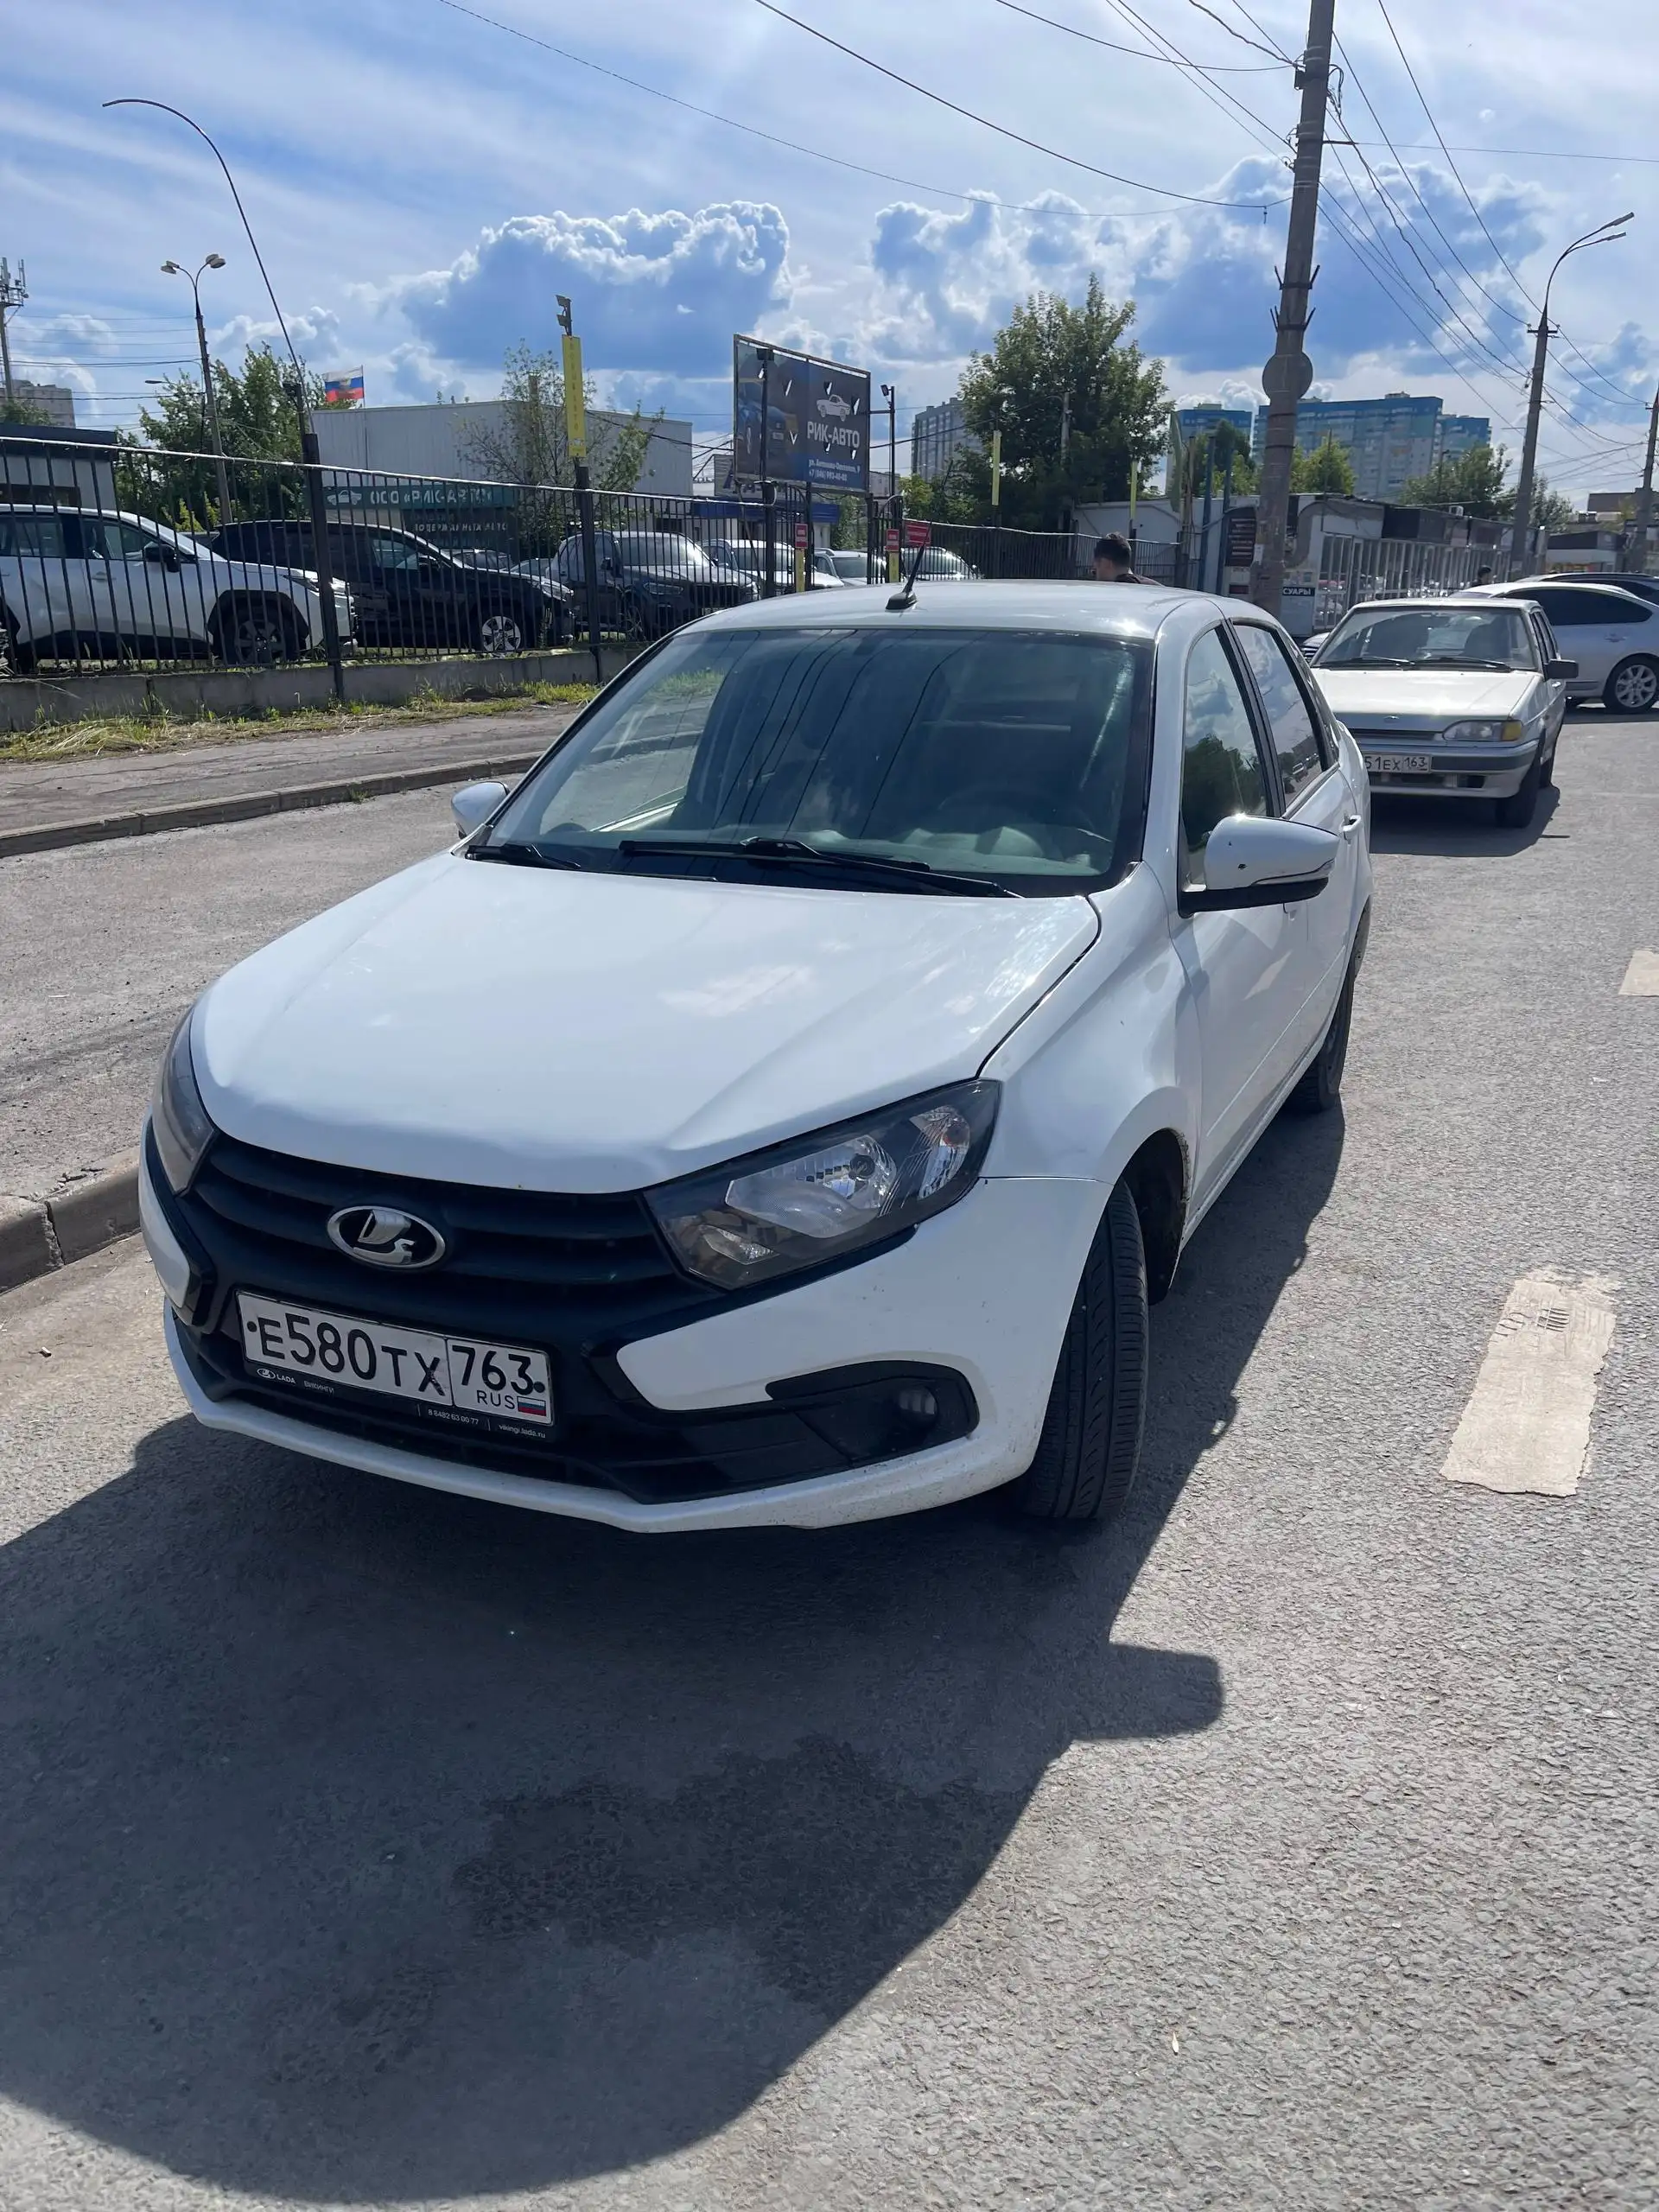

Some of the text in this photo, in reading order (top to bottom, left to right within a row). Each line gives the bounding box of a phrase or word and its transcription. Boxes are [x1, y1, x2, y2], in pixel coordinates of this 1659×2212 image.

[807, 421, 861, 448] РИК-АВТО
[1404, 757, 1426, 768] 163
[257, 1313, 534, 1397] Е580ТХ 763
[276, 1374, 296, 1384] LADA
[477, 1389, 516, 1410] RUS
[451, 1413, 461, 1421] 63
